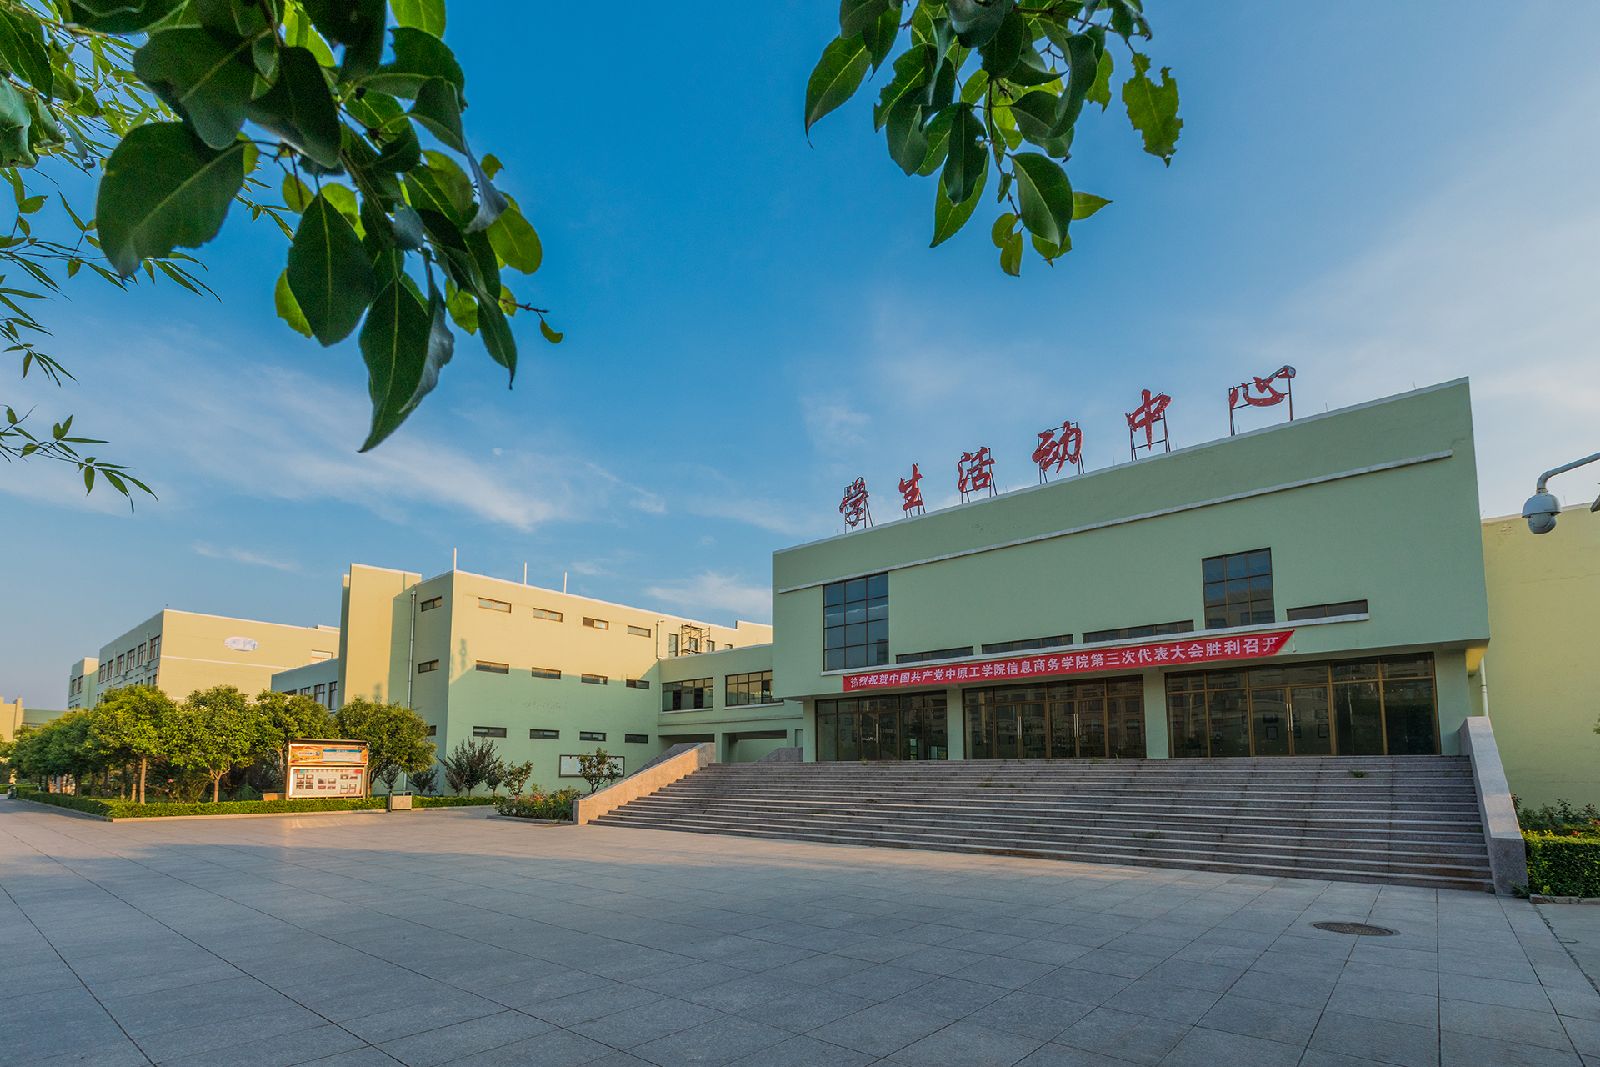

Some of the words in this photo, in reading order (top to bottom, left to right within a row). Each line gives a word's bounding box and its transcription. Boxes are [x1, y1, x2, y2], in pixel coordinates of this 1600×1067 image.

[840, 365, 1296, 527] 学生活动中心
